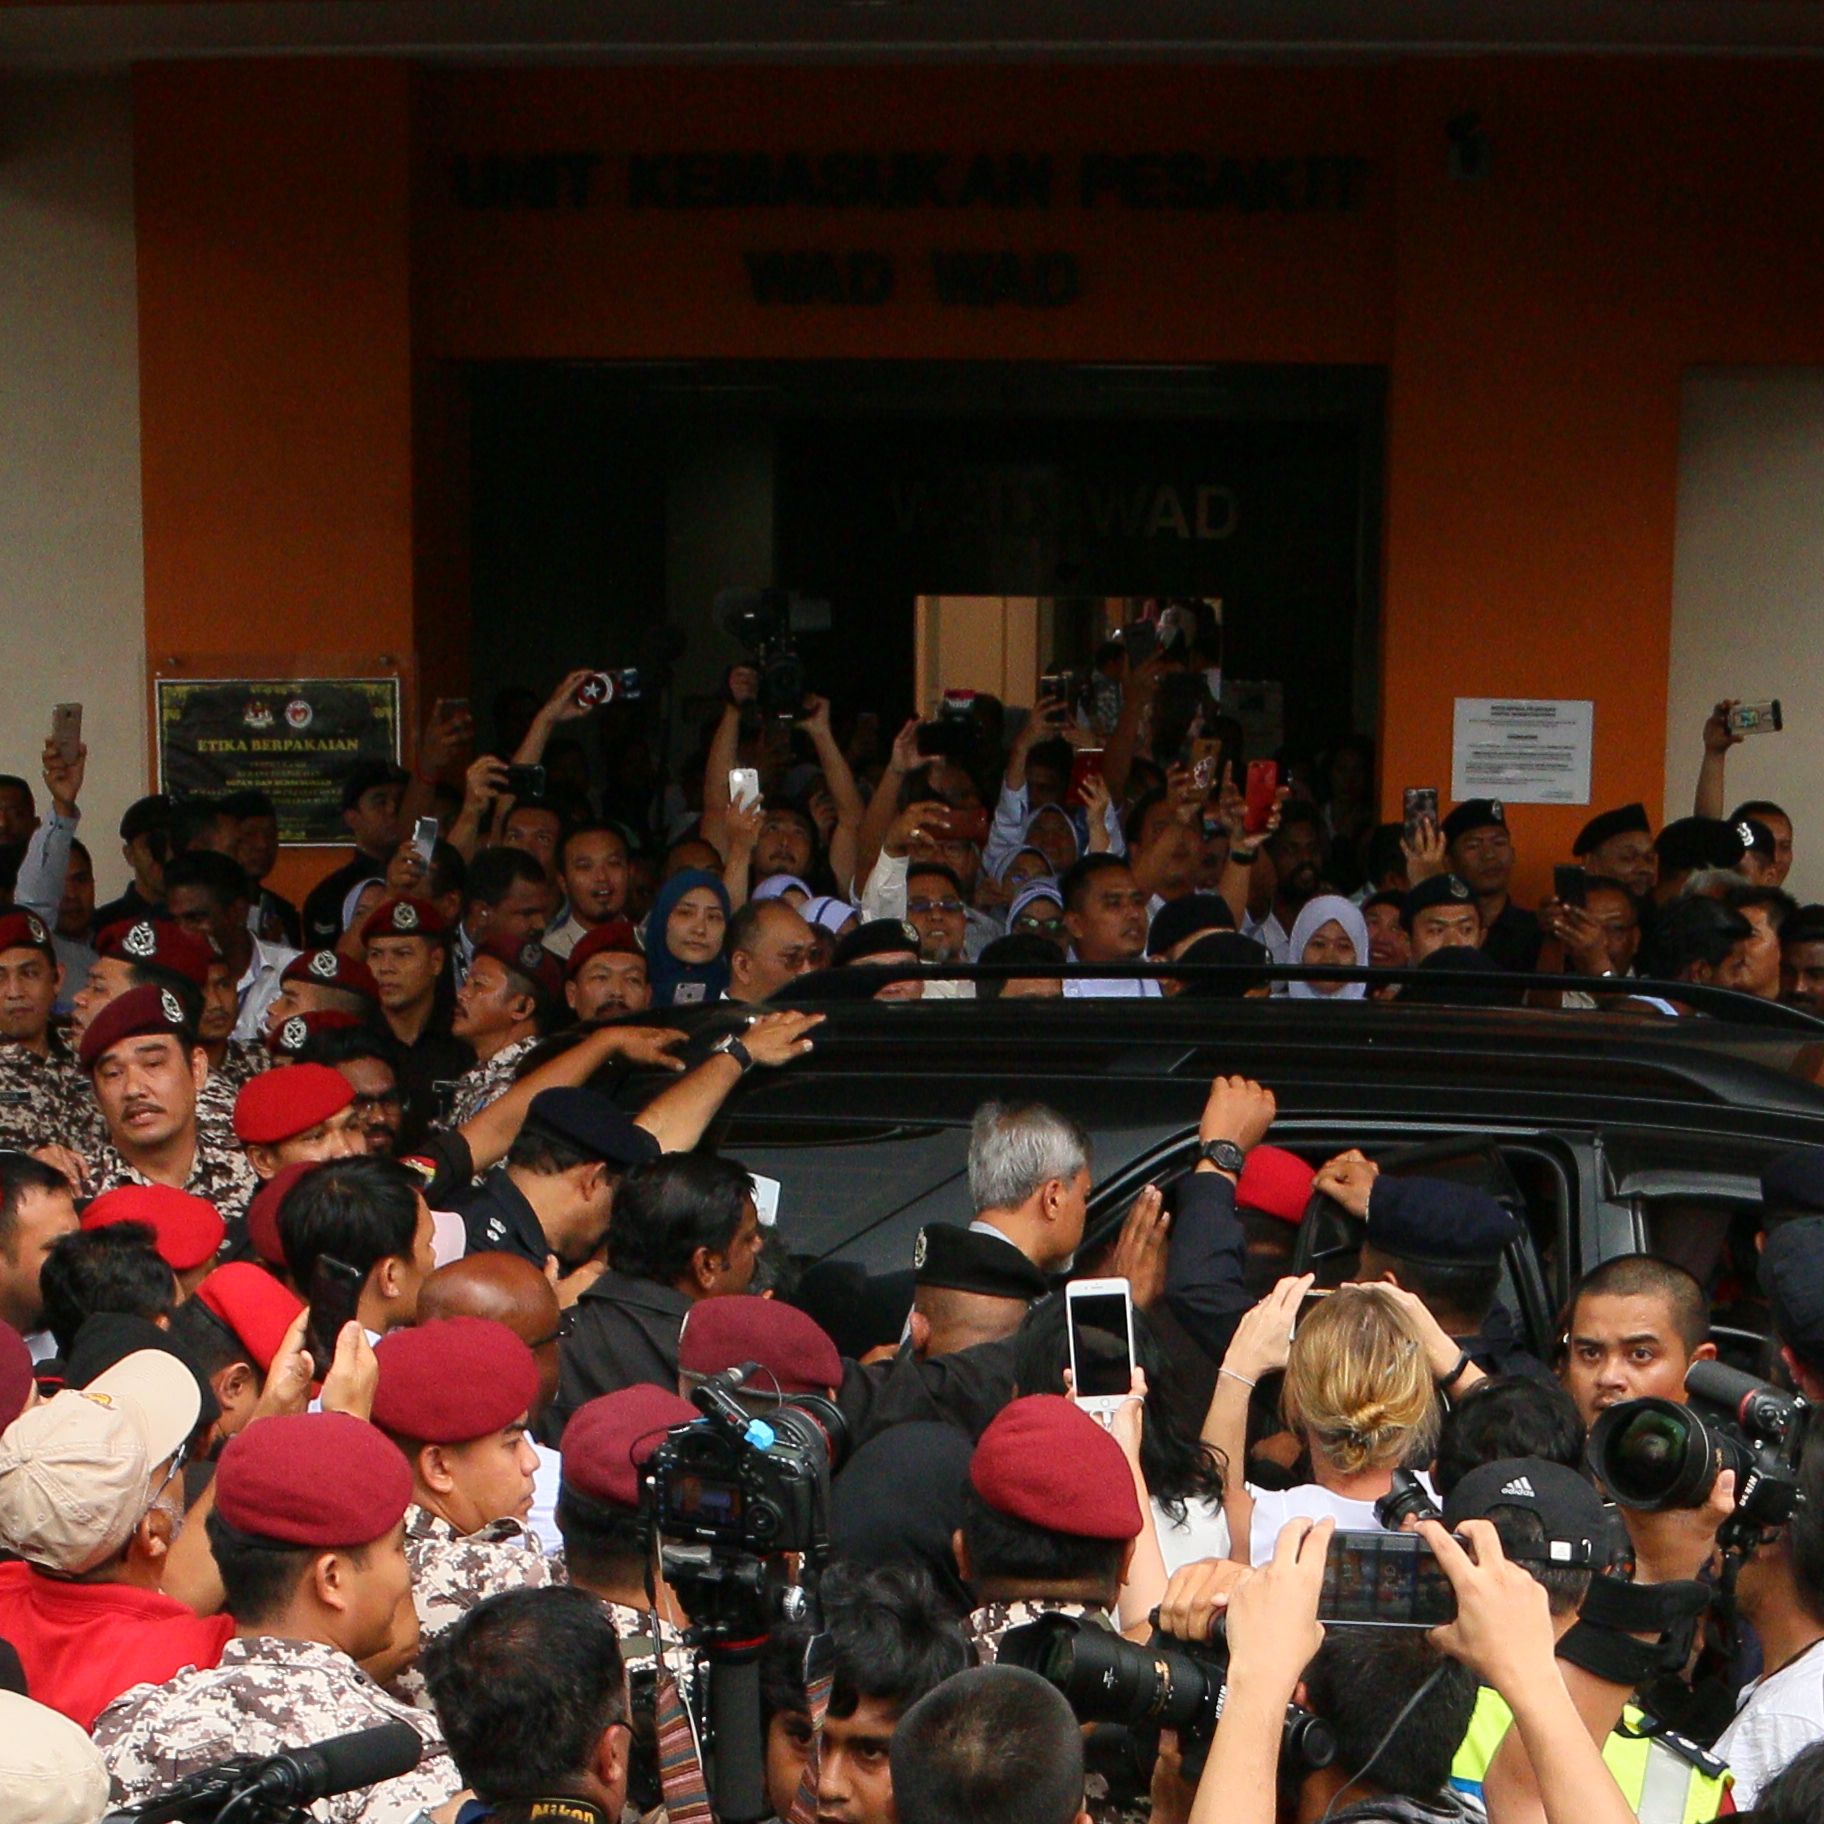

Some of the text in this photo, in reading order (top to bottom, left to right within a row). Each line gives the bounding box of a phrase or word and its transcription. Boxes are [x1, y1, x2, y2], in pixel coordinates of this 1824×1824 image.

[453, 151, 1370, 213] UNIT KEMASUKAN PESAKIT
[743, 249, 1081, 308] WAD WAD
[196, 737, 360, 752] ETIKA BERPAKAIAN
